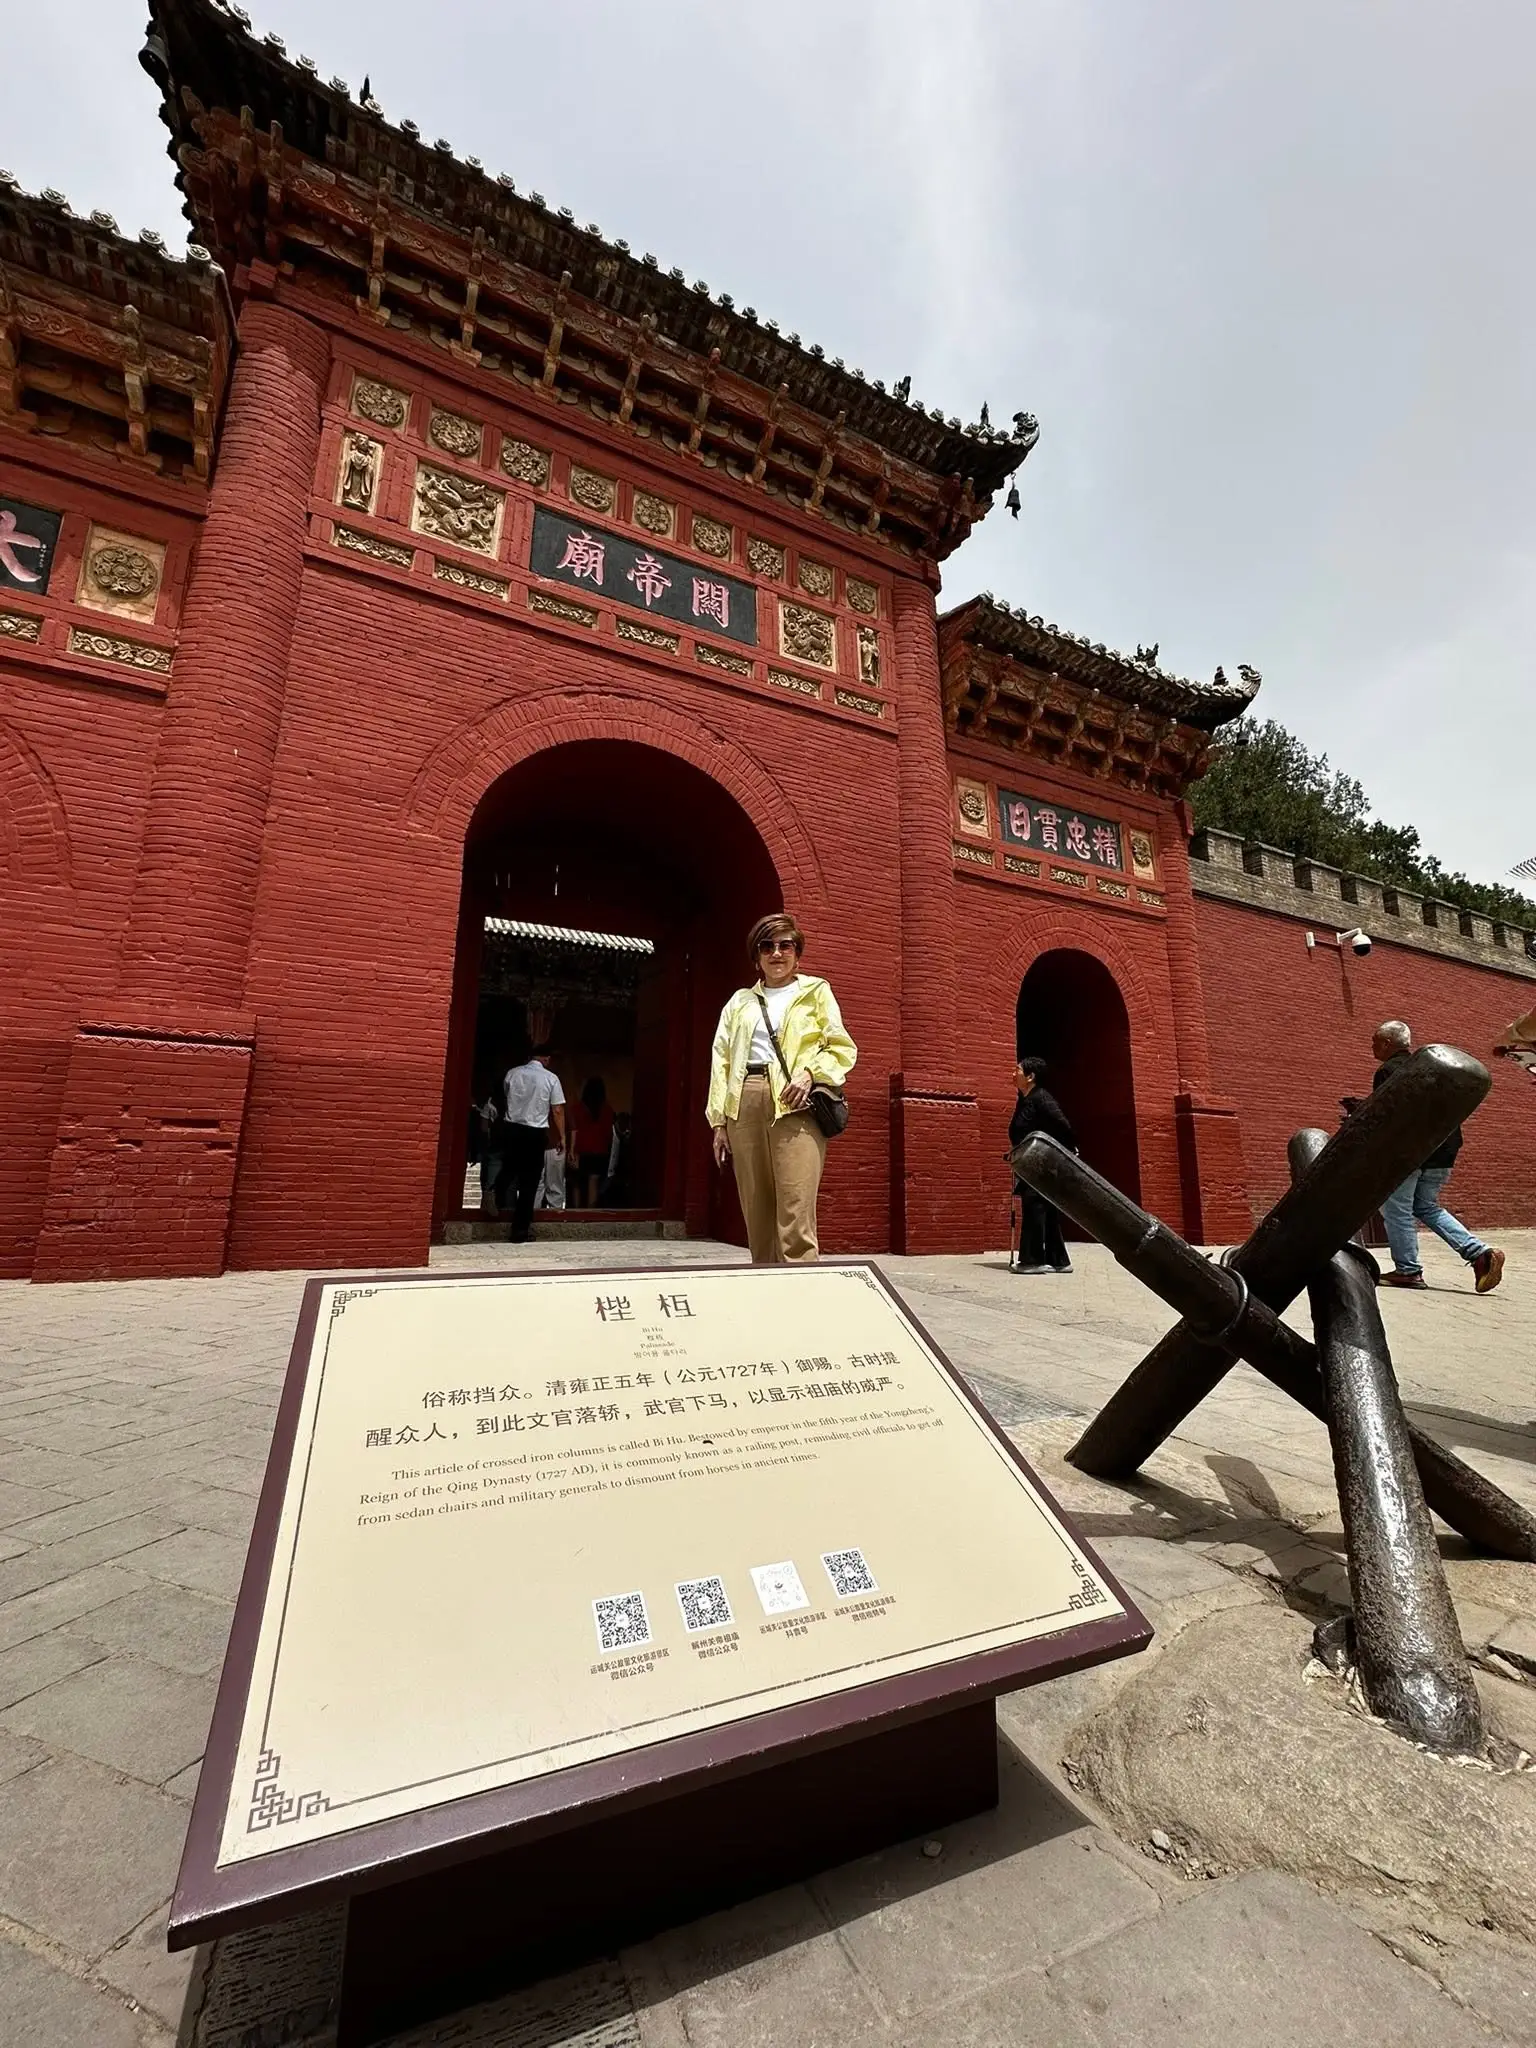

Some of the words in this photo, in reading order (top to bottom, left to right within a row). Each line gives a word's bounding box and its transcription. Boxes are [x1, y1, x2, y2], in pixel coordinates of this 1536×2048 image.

[556, 530, 730, 629] 關帝廟
[359, 1491, 399, 1505] Reign
[403, 1486, 419, 1499] of
[421, 1484, 443, 1496] the
[446, 1480, 479, 1494] Qing
[482, 1473, 532, 1489] Dynasty
[535, 1468, 567, 1482] (1727
[571, 1463, 598, 1476] AD),
[600, 1461, 610, 1472] it
[612, 1459, 623, 1470] is
[625, 1452, 682, 1468] commonly
[683, 1448, 720, 1460] known
[721, 1447, 734, 1455] as
[735, 1445, 743, 1454] a
[744, 1440, 778, 1452] railing
[778, 1437, 803, 1450] post,
[803, 1431, 852, 1444] reminding
[851, 1426, 871, 1438] civil
[872, 1423, 906, 1435] officials
[904, 1423, 916, 1431] to
[916, 1420, 931, 1431] get
[931, 1417, 944, 1427] off
[390, 1468, 421, 1481] This
[423, 1462, 464, 1477] article
[466, 1459, 480, 1471] of
[482, 1453, 527, 1469] crossed
[530, 1452, 554, 1463] iron
[556, 1446, 605, 1459] columns
[606, 1443, 617, 1453] is
[618, 1438, 651, 1451] called
[651, 1436, 664, 1447] Bi
[665, 1435, 686, 1445] Hu.
[687, 1428, 736, 1443] Bestowed
[734, 1427, 748, 1438] by
[750, 1423, 790, 1435] emperor
[790, 1421, 802, 1430] in
[802, 1418, 818, 1428] the
[818, 1415, 839, 1426] fifth
[838, 1415, 858, 1426] year
[858, 1411, 869, 1422] of
[868, 1410, 884, 1420] the
[882, 1404, 935, 1418] Yongzheng's
[357, 1513, 391, 1526] from
[394, 1506, 434, 1521] sedan
[437, 1500, 478, 1514] chairs
[480, 1493, 505, 1508] and
[508, 1489, 557, 1504] military
[558, 1480, 608, 1499] generals
[609, 1479, 622, 1489] to
[624, 1471, 677, 1487] dismount
[677, 1468, 705, 1479] from
[704, 1463, 740, 1475] horses
[740, 1460, 752, 1470] in
[753, 1455, 790, 1468] ancient
[790, 1452, 821, 1463] times.
[610, 1662, 654, 1681] 微信公众号
[698, 1643, 739, 1659] 微信公众号
